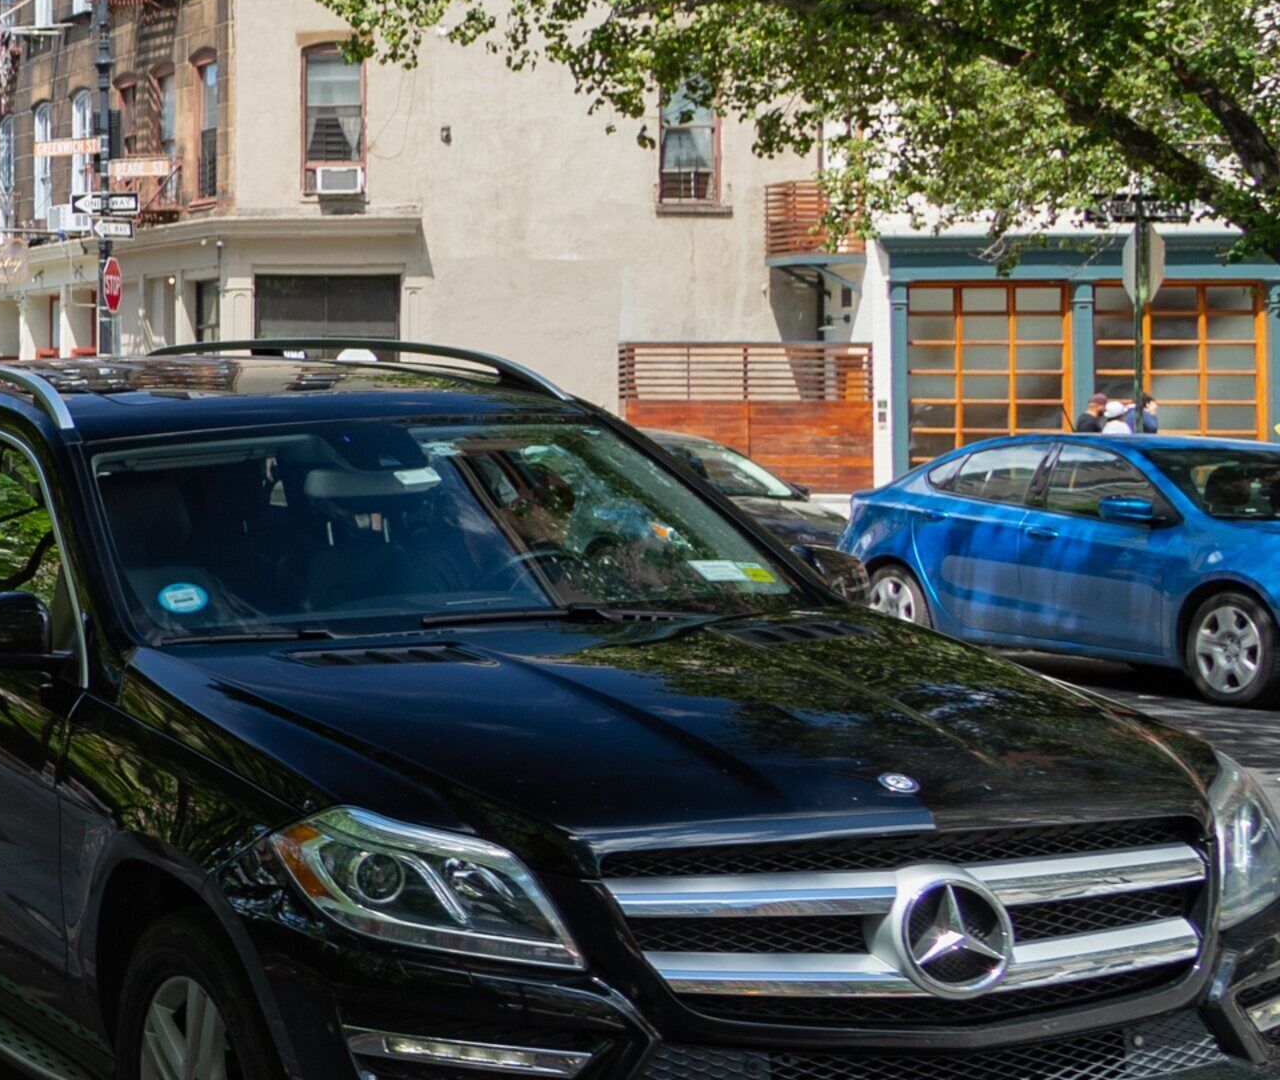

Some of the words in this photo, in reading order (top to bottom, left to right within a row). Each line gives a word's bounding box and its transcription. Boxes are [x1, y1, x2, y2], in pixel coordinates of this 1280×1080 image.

[36, 140, 83, 156] GREENWICH
[86, 139, 97, 153] ST
[115, 161, 144, 176] READE
[152, 161, 164, 174] ST
[111, 199, 131, 207] WAY
[1100, 200, 1131, 215] ONE
[105, 275, 121, 295] STOP
